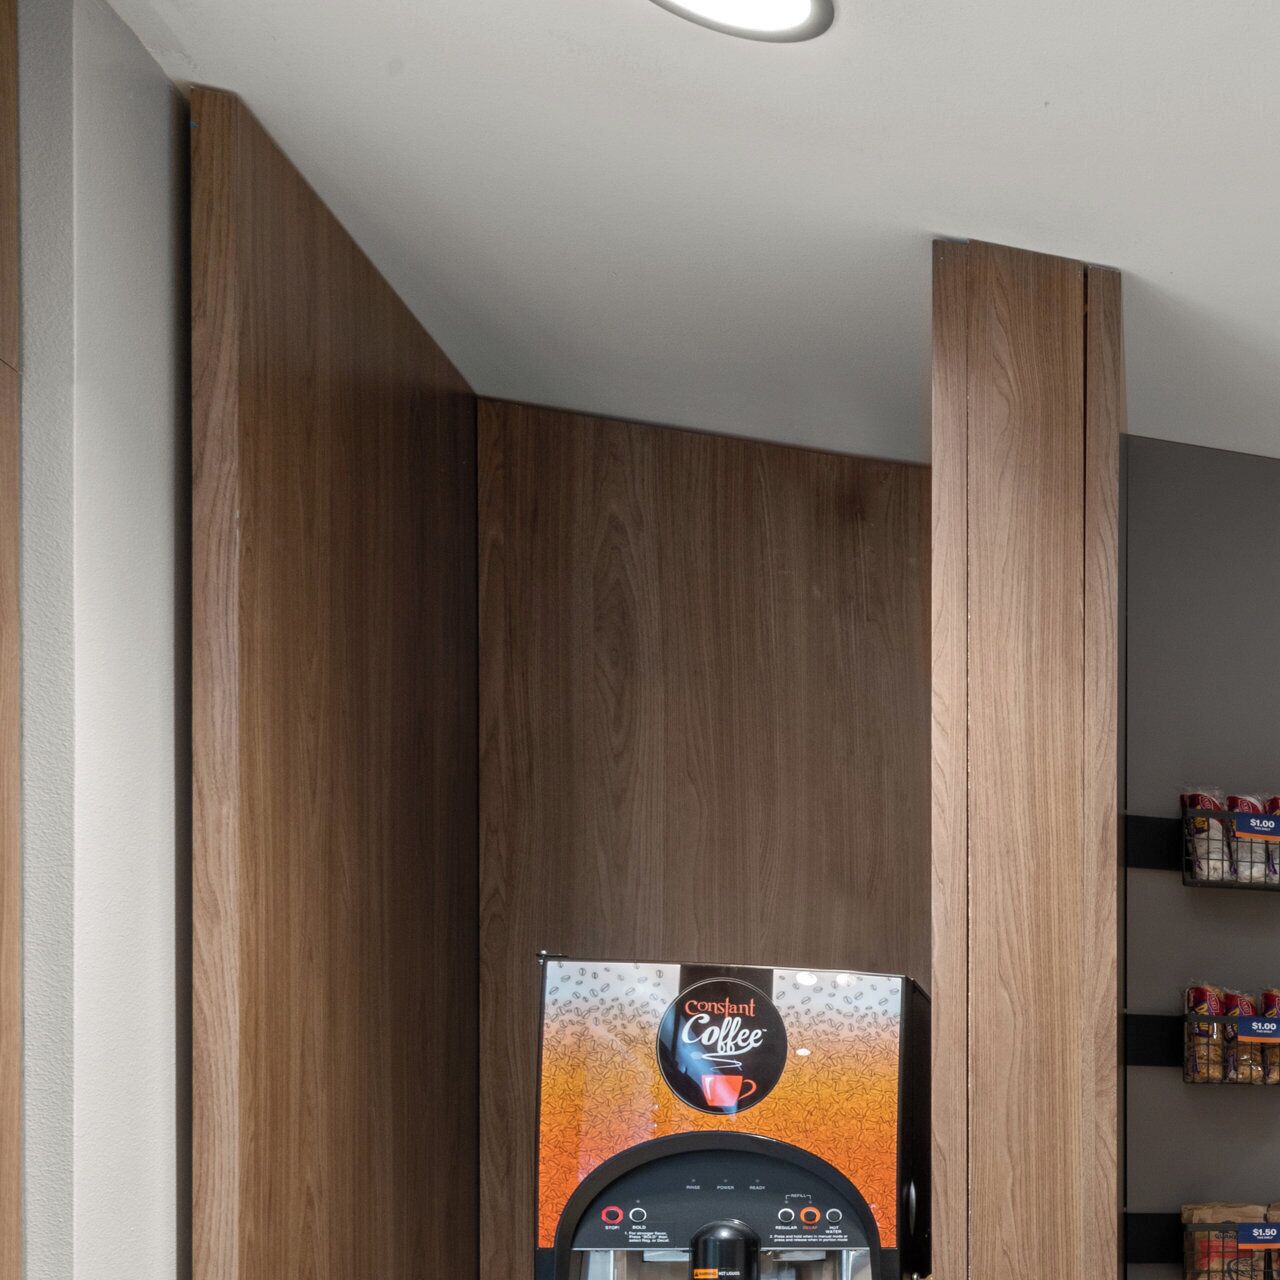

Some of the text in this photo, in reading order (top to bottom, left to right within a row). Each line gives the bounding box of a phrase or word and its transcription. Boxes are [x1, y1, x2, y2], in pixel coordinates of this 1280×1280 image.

[1250, 818, 1275, 828] $1.00
[685, 997, 756, 1018] Constant
[1252, 1022, 1276, 1030] $1.00
[682, 1013, 764, 1055] Coffee
[1252, 1228, 1276, 1236] $1.50
